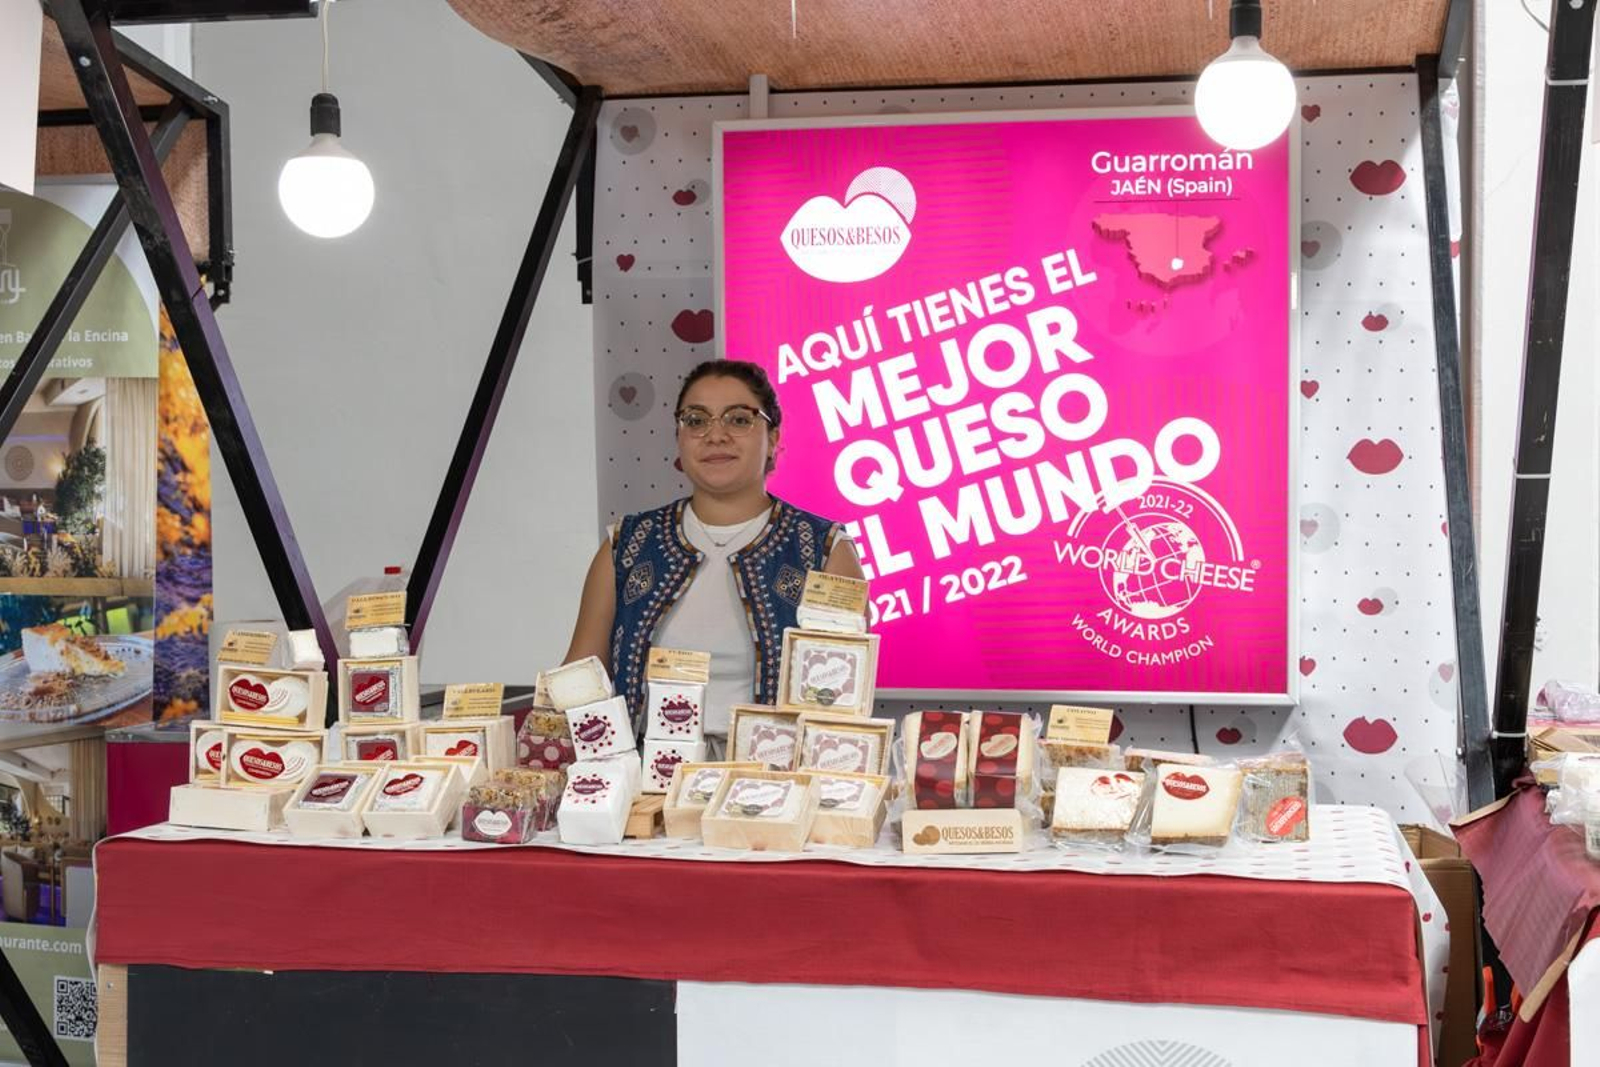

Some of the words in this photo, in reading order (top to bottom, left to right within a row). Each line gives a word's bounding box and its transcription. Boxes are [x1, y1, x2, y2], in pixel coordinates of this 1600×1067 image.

[1091, 147, 1253, 174] Guarromán
[1110, 176, 1162, 195] JAÉN
[1167, 176, 1233, 197] (Spain)
[791, 227, 901, 249] QUESOS&BESOS
[778, 305, 883, 384] AQUÍ
[886, 266, 1035, 343] TIENES
[1041, 248, 1097, 294] EL
[85, 330, 129, 342] Encina
[812, 306, 1094, 443] MEJOR
[833, 373, 1108, 506] QUESO
[918, 416, 1220, 559] MUNDO
[1138, 494, 1194, 519] 2021-22
[1053, 540, 1155, 575] WORLD
[939, 555, 1028, 603] 2022
[1071, 614, 1122, 658] WORLD
[1126, 635, 1214, 665] CHAMPION
[1097, 608, 1190, 640] AWARDS
[941, 826, 1014, 842] QUESOS&BESOS
[0, 936, 82, 954] urante.com
